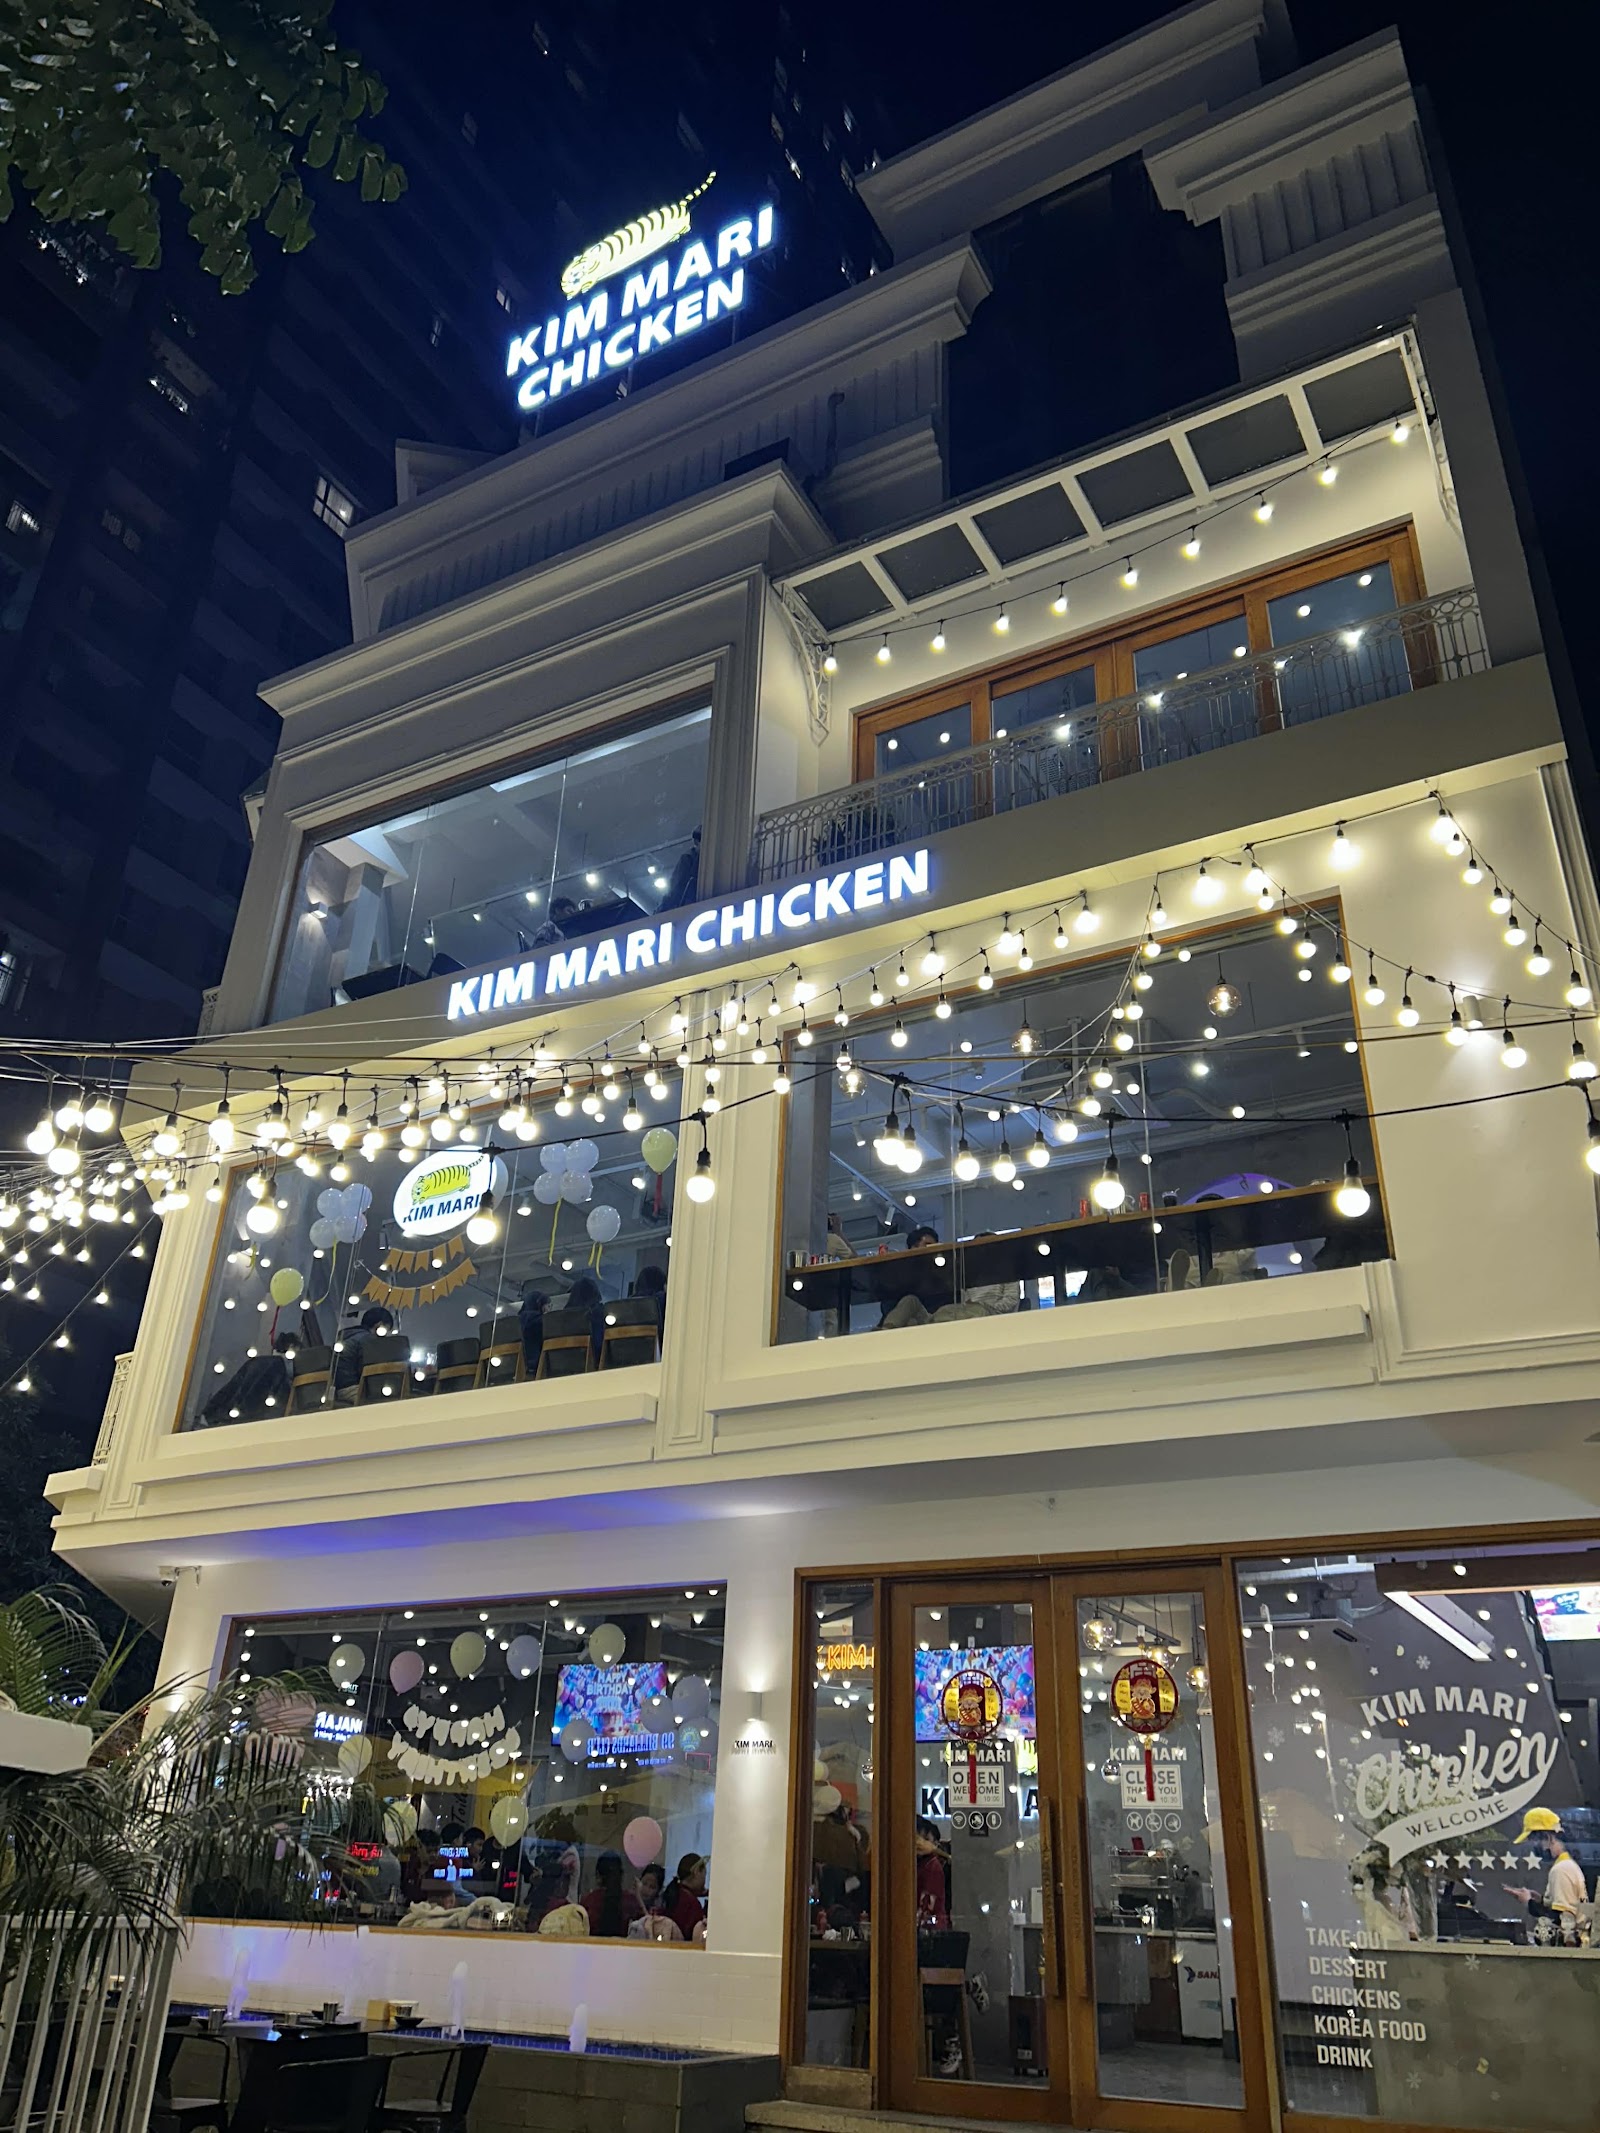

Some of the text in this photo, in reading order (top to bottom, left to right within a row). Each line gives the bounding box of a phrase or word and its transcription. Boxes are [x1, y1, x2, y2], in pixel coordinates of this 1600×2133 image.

[506, 205, 773, 378] KIM MARI
[517, 268, 745, 410] CHICKEN
[447, 848, 930, 1021] KIM MARI CHICKEN
[437, 1194, 480, 1217] MARI
[827, 1644, 868, 1670] KIM
[586, 1682, 634, 1696] BIRTHDAY
[597, 1670, 627, 1683] HAPPY
[1360, 1686, 1527, 1727] KIM MARI
[735, 1740, 773, 1748] KIM MARI
[1110, 1747, 1141, 1760] KIM
[953, 1771, 999, 1784] OEN
[1355, 1729, 1559, 1820] Chicken
[1158, 1786, 1176, 1794] YOU
[1406, 1799, 1509, 1838] WELCOME
[1306, 1927, 1351, 1948] TAKE
[1309, 1957, 1387, 1980] DESSERT
[1311, 1985, 1402, 2010] CHICKENS
[1314, 2014, 1428, 2042] KOREA FOOD
[1316, 2044, 1374, 2069] DRINK
